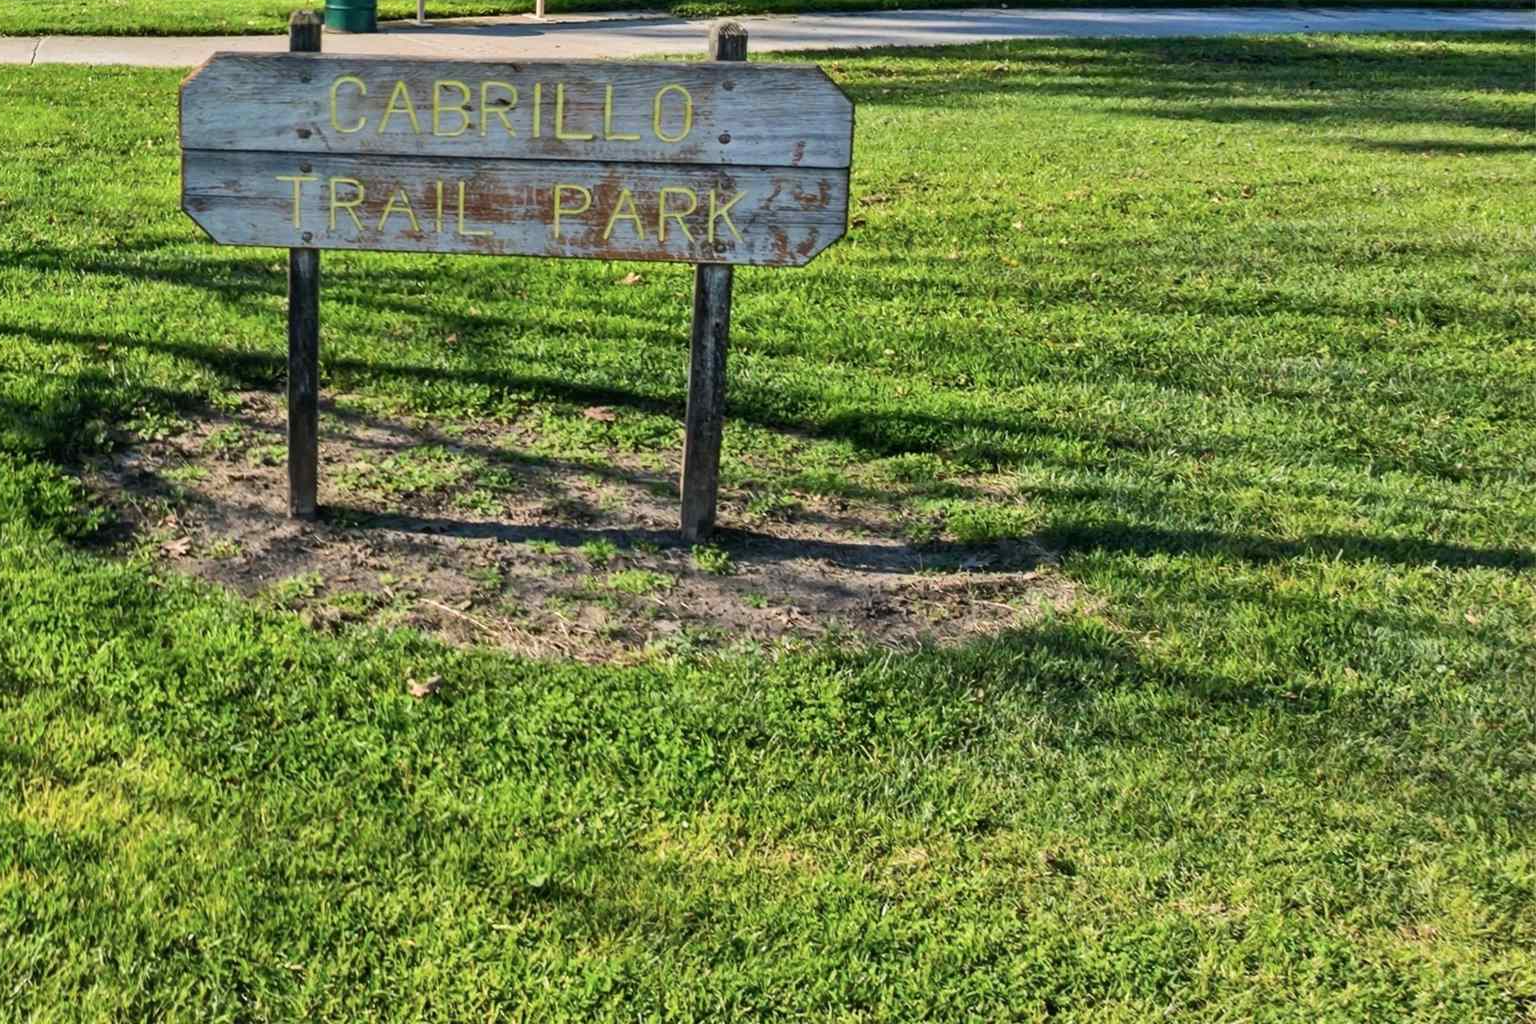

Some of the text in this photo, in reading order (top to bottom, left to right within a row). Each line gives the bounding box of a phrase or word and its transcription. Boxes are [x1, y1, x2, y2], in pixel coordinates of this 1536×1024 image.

[329, 75, 694, 142] CABRILLO
[276, 175, 750, 243] TRAIL PARK
